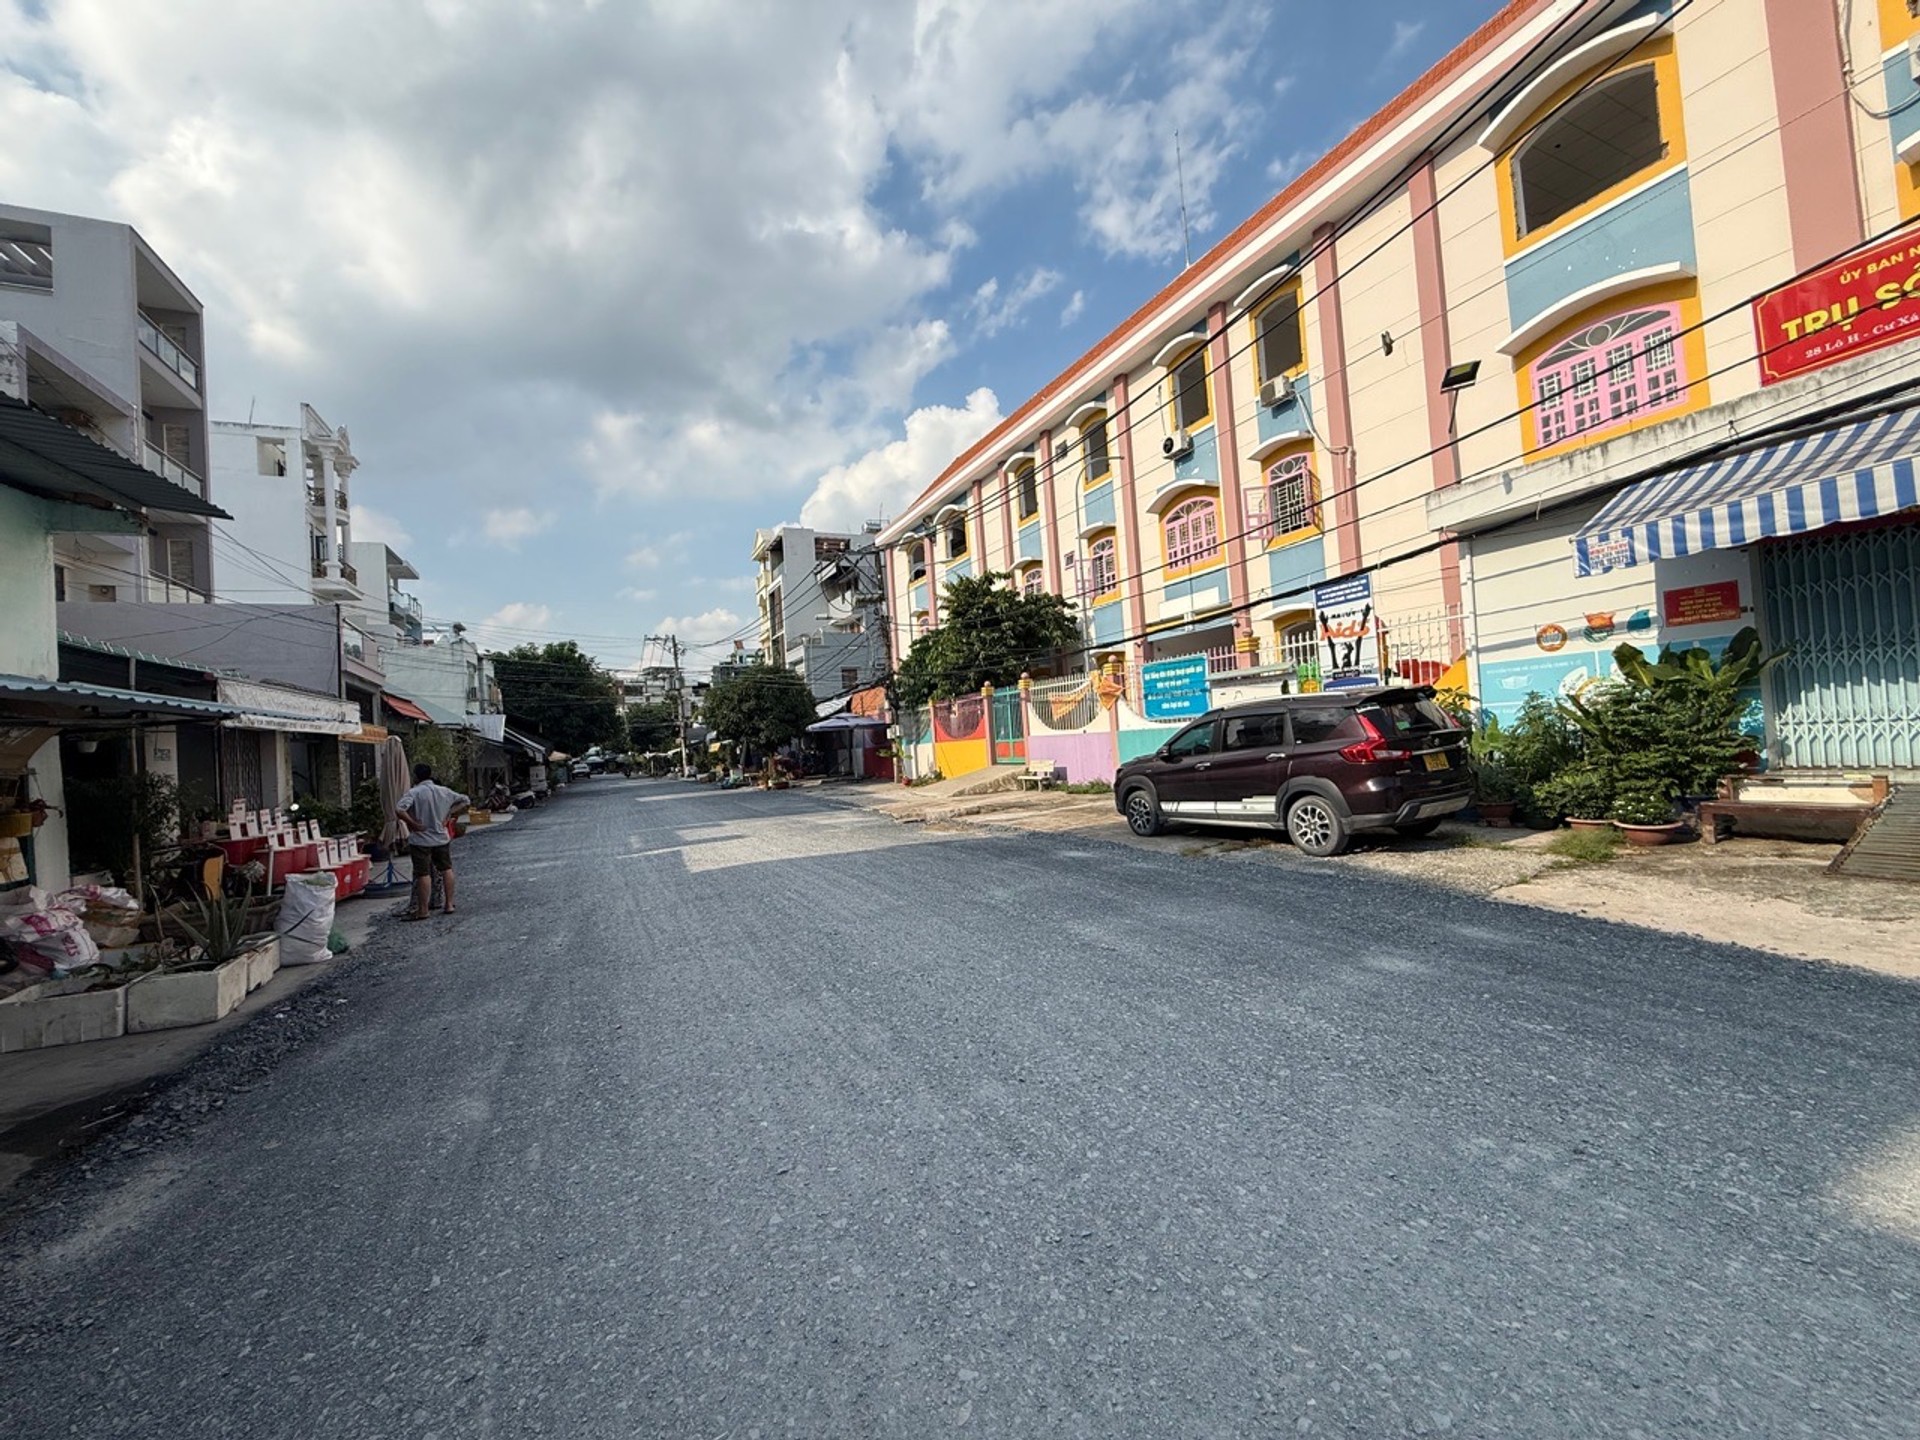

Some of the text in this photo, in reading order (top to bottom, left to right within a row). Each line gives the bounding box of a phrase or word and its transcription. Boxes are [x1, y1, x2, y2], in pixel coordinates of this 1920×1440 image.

[1866, 251, 1904, 275] BAN
[1780, 296, 1860, 342] TRỤ
[1804, 346, 1822, 359] 28
[1847, 333, 1860, 344] H
[1872, 320, 1896, 335] Cư
